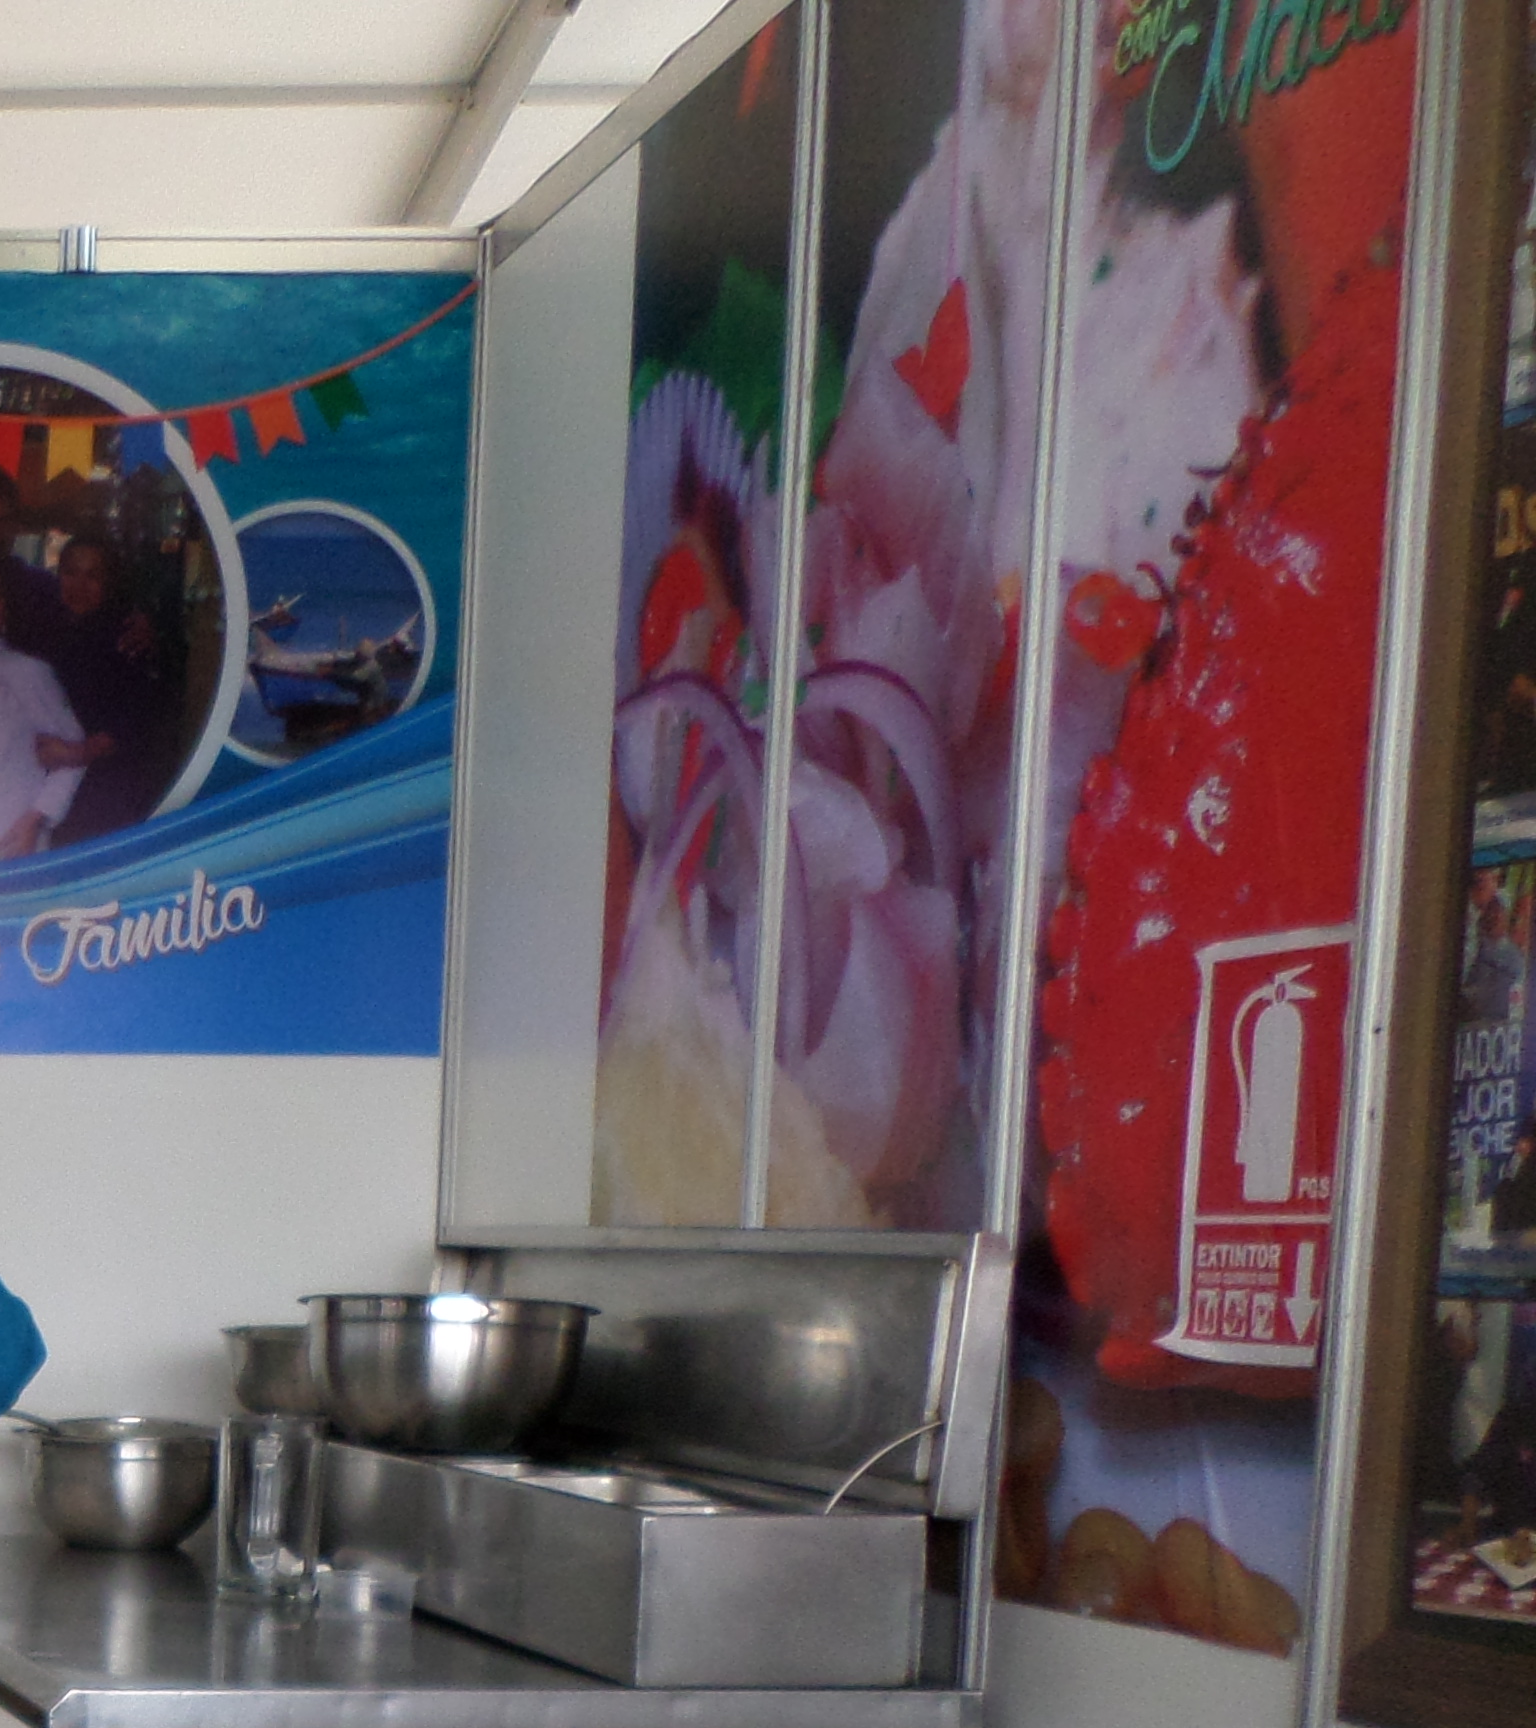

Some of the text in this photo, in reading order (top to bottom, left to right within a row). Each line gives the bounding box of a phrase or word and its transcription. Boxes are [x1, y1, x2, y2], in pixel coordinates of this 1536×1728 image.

[22, 869, 263, 984] Familia
[1452, 1078, 1516, 1125] JOR
[1197, 1243, 1282, 1268] EXTINTOR
